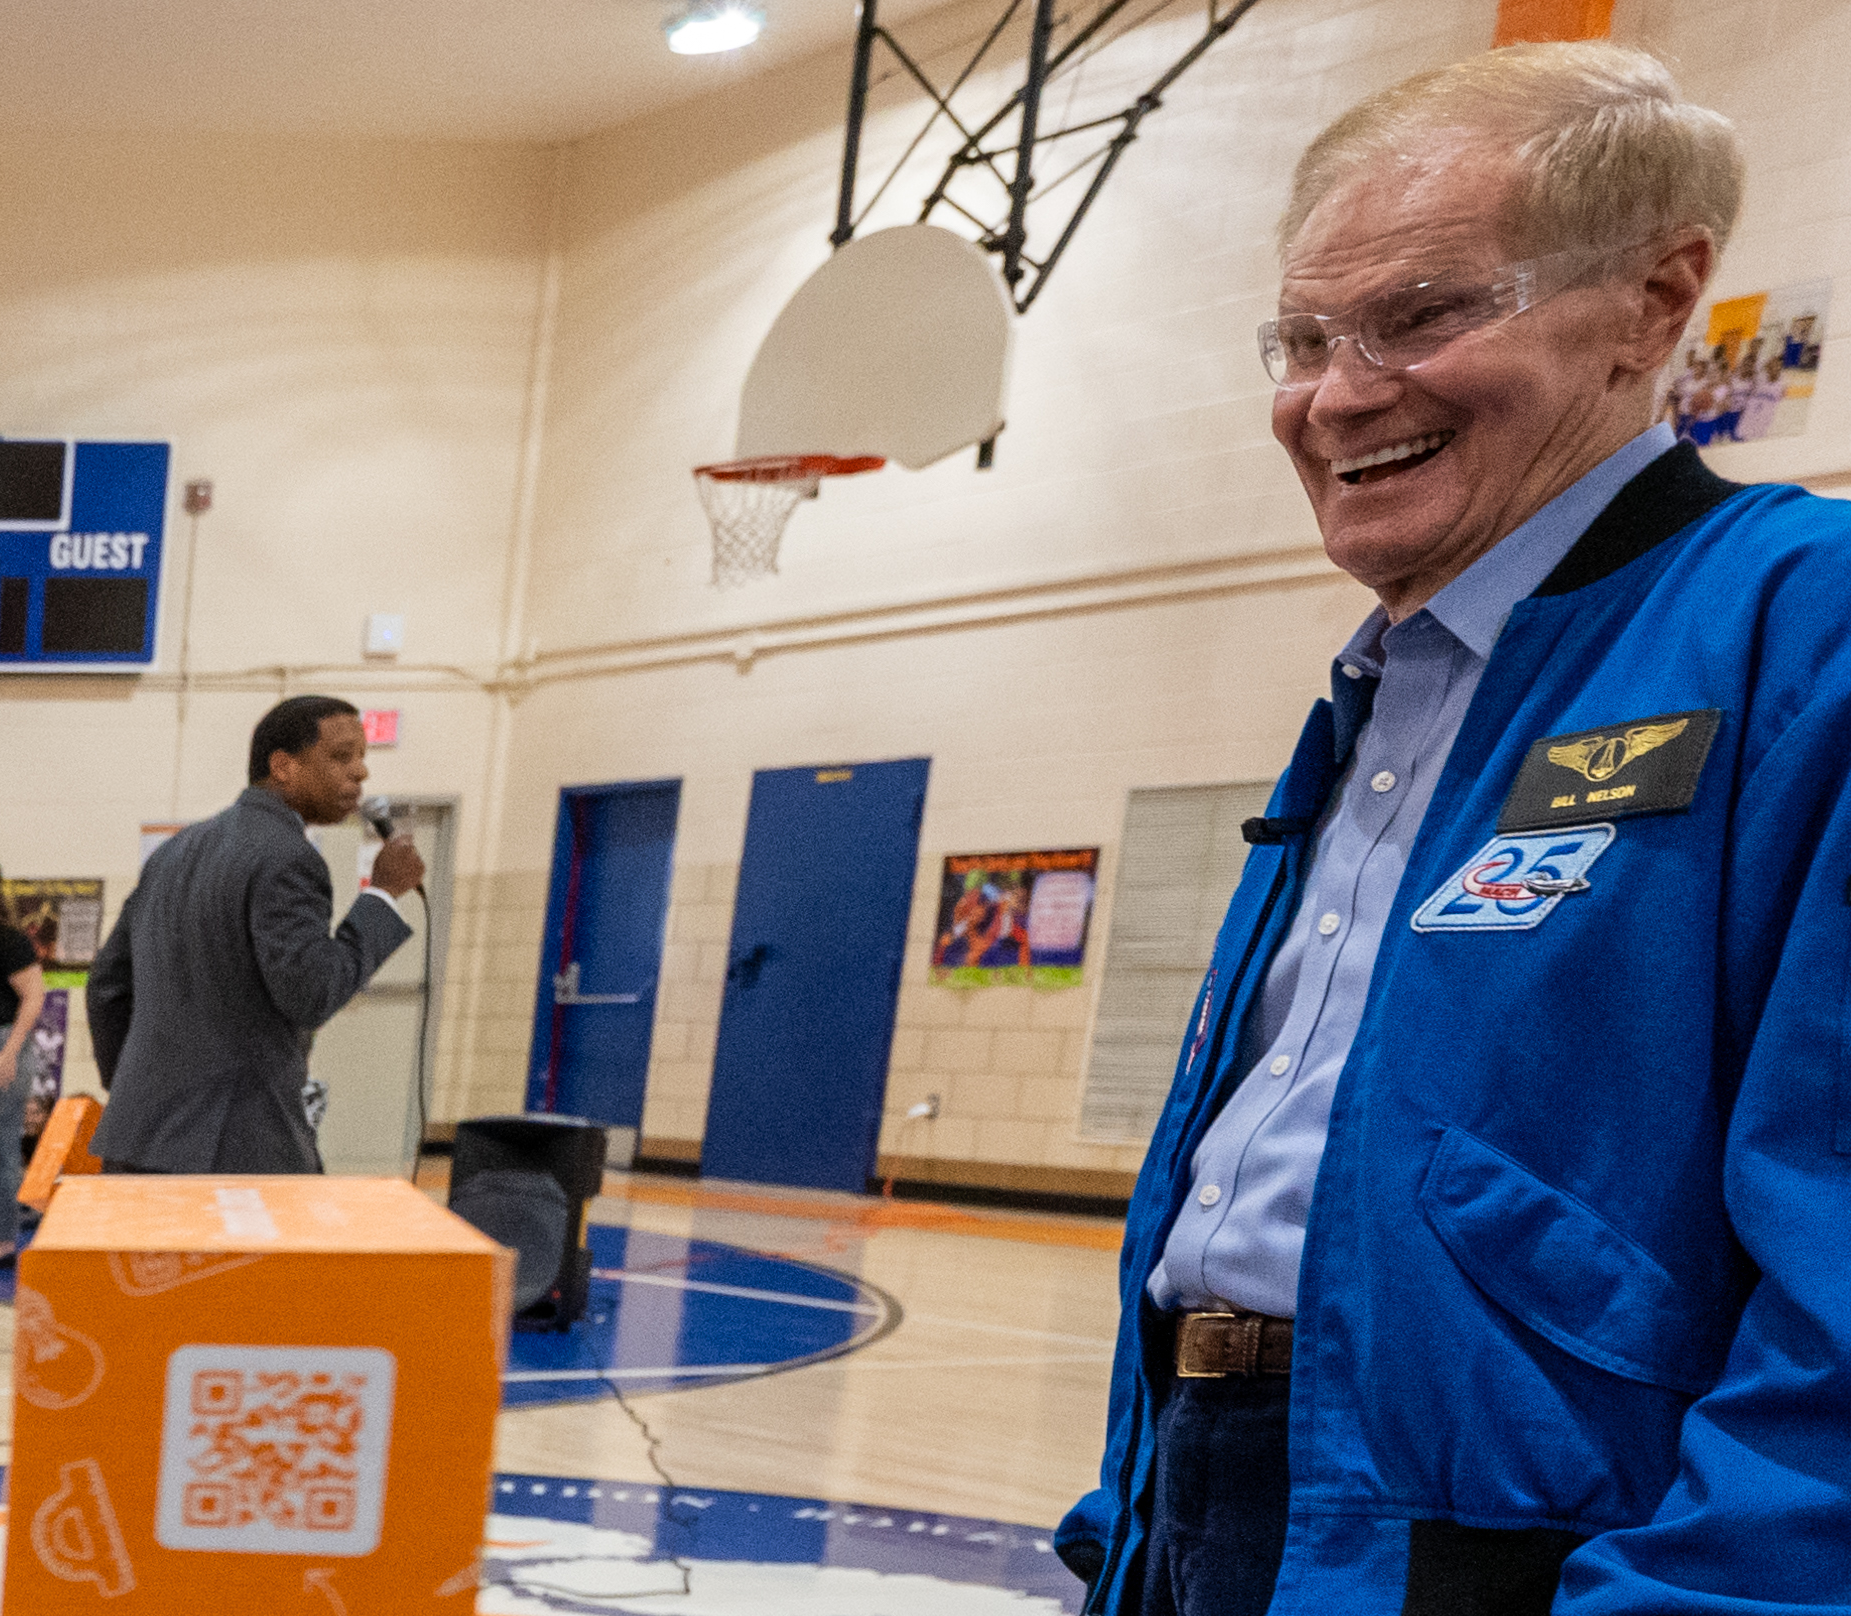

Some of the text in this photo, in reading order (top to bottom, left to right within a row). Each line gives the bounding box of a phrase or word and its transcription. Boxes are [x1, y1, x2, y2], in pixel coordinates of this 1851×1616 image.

[49, 532, 149, 570] GUEST
[1550, 785, 1637, 809] BILL NELSON
[1437, 841, 1585, 916] 25
